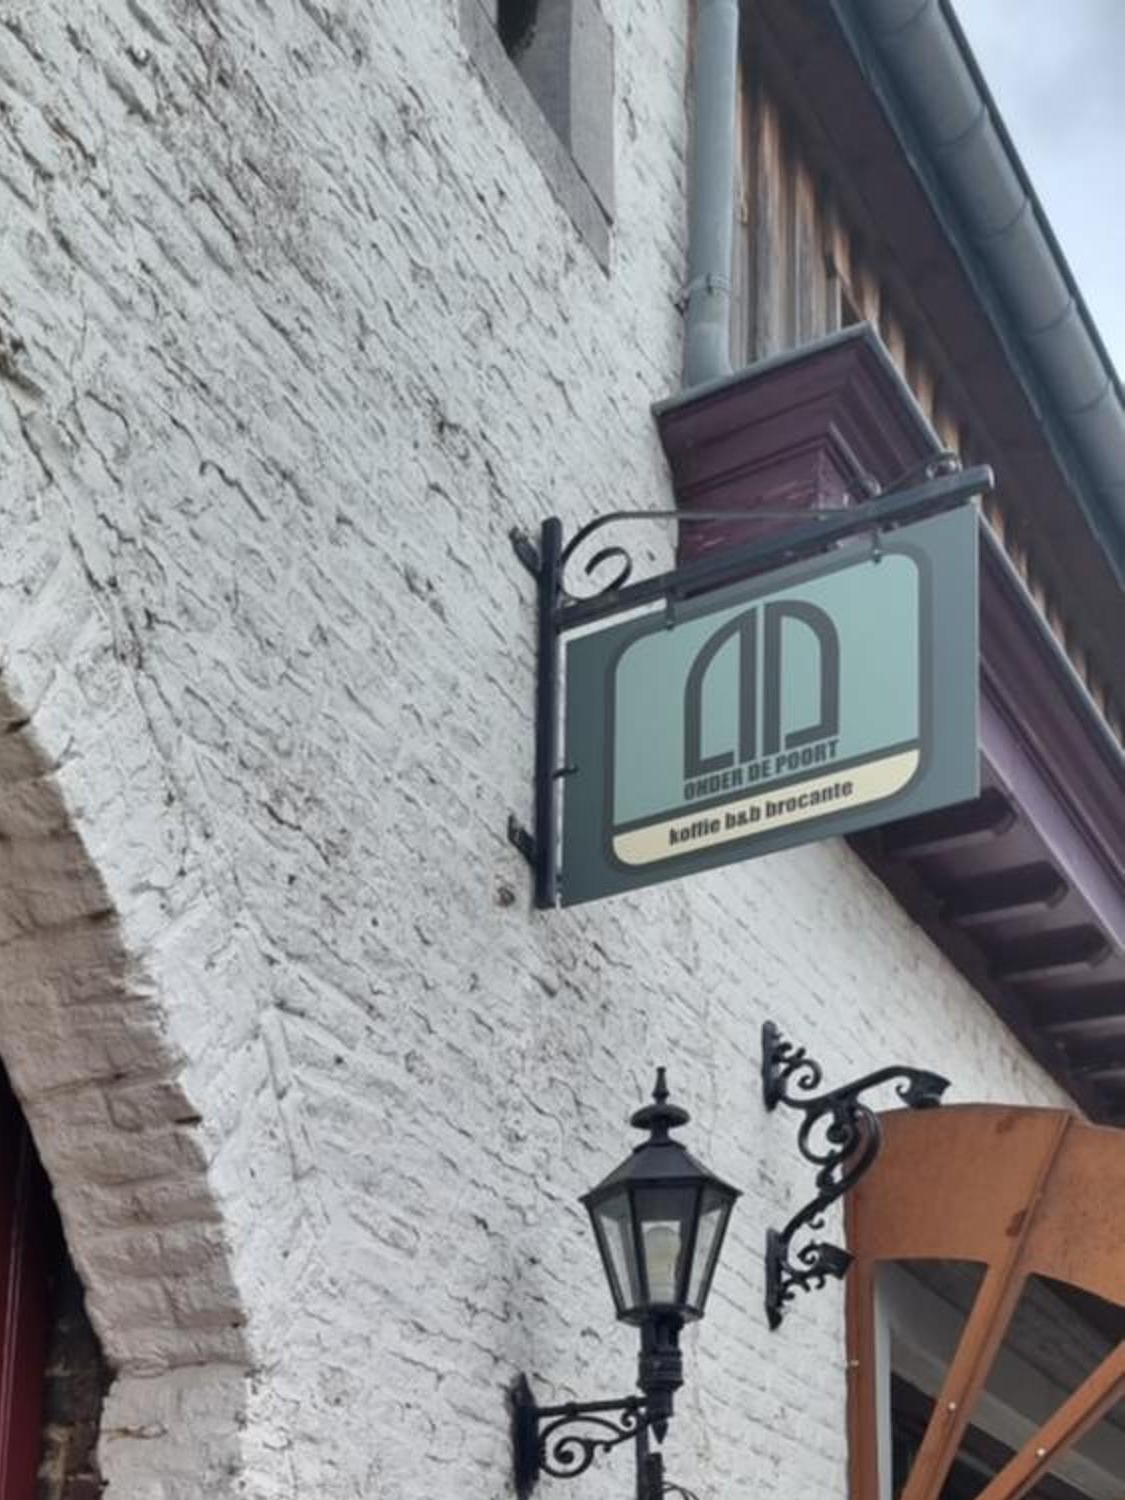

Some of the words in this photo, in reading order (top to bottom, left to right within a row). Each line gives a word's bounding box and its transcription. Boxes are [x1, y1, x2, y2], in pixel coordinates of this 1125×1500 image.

[684, 767, 743, 800] ONDER
[748, 759, 773, 782] DE
[776, 739, 839, 773] POORT
[669, 818, 721, 846] koffie
[725, 805, 760, 830] b&b
[765, 780, 854, 819] brocante
